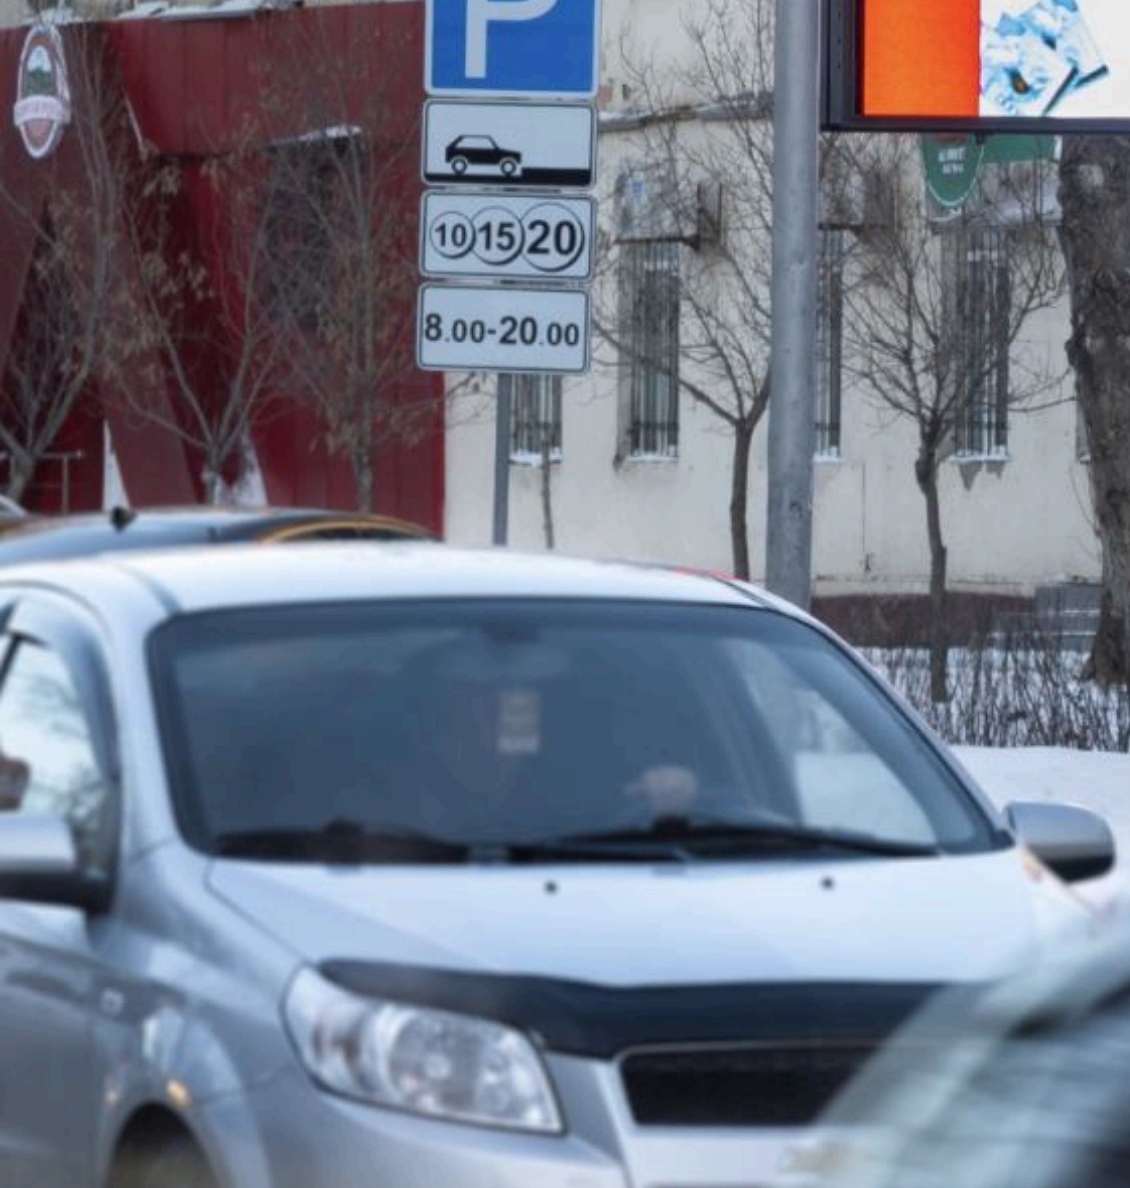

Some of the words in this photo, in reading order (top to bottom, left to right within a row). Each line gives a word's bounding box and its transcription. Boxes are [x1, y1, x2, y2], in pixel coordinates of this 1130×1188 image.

[435, 222, 467, 247] 10
[477, 220, 515, 252] 15
[526, 219, 577, 256] 20
[424, 312, 580, 348] 8.00-20.00
